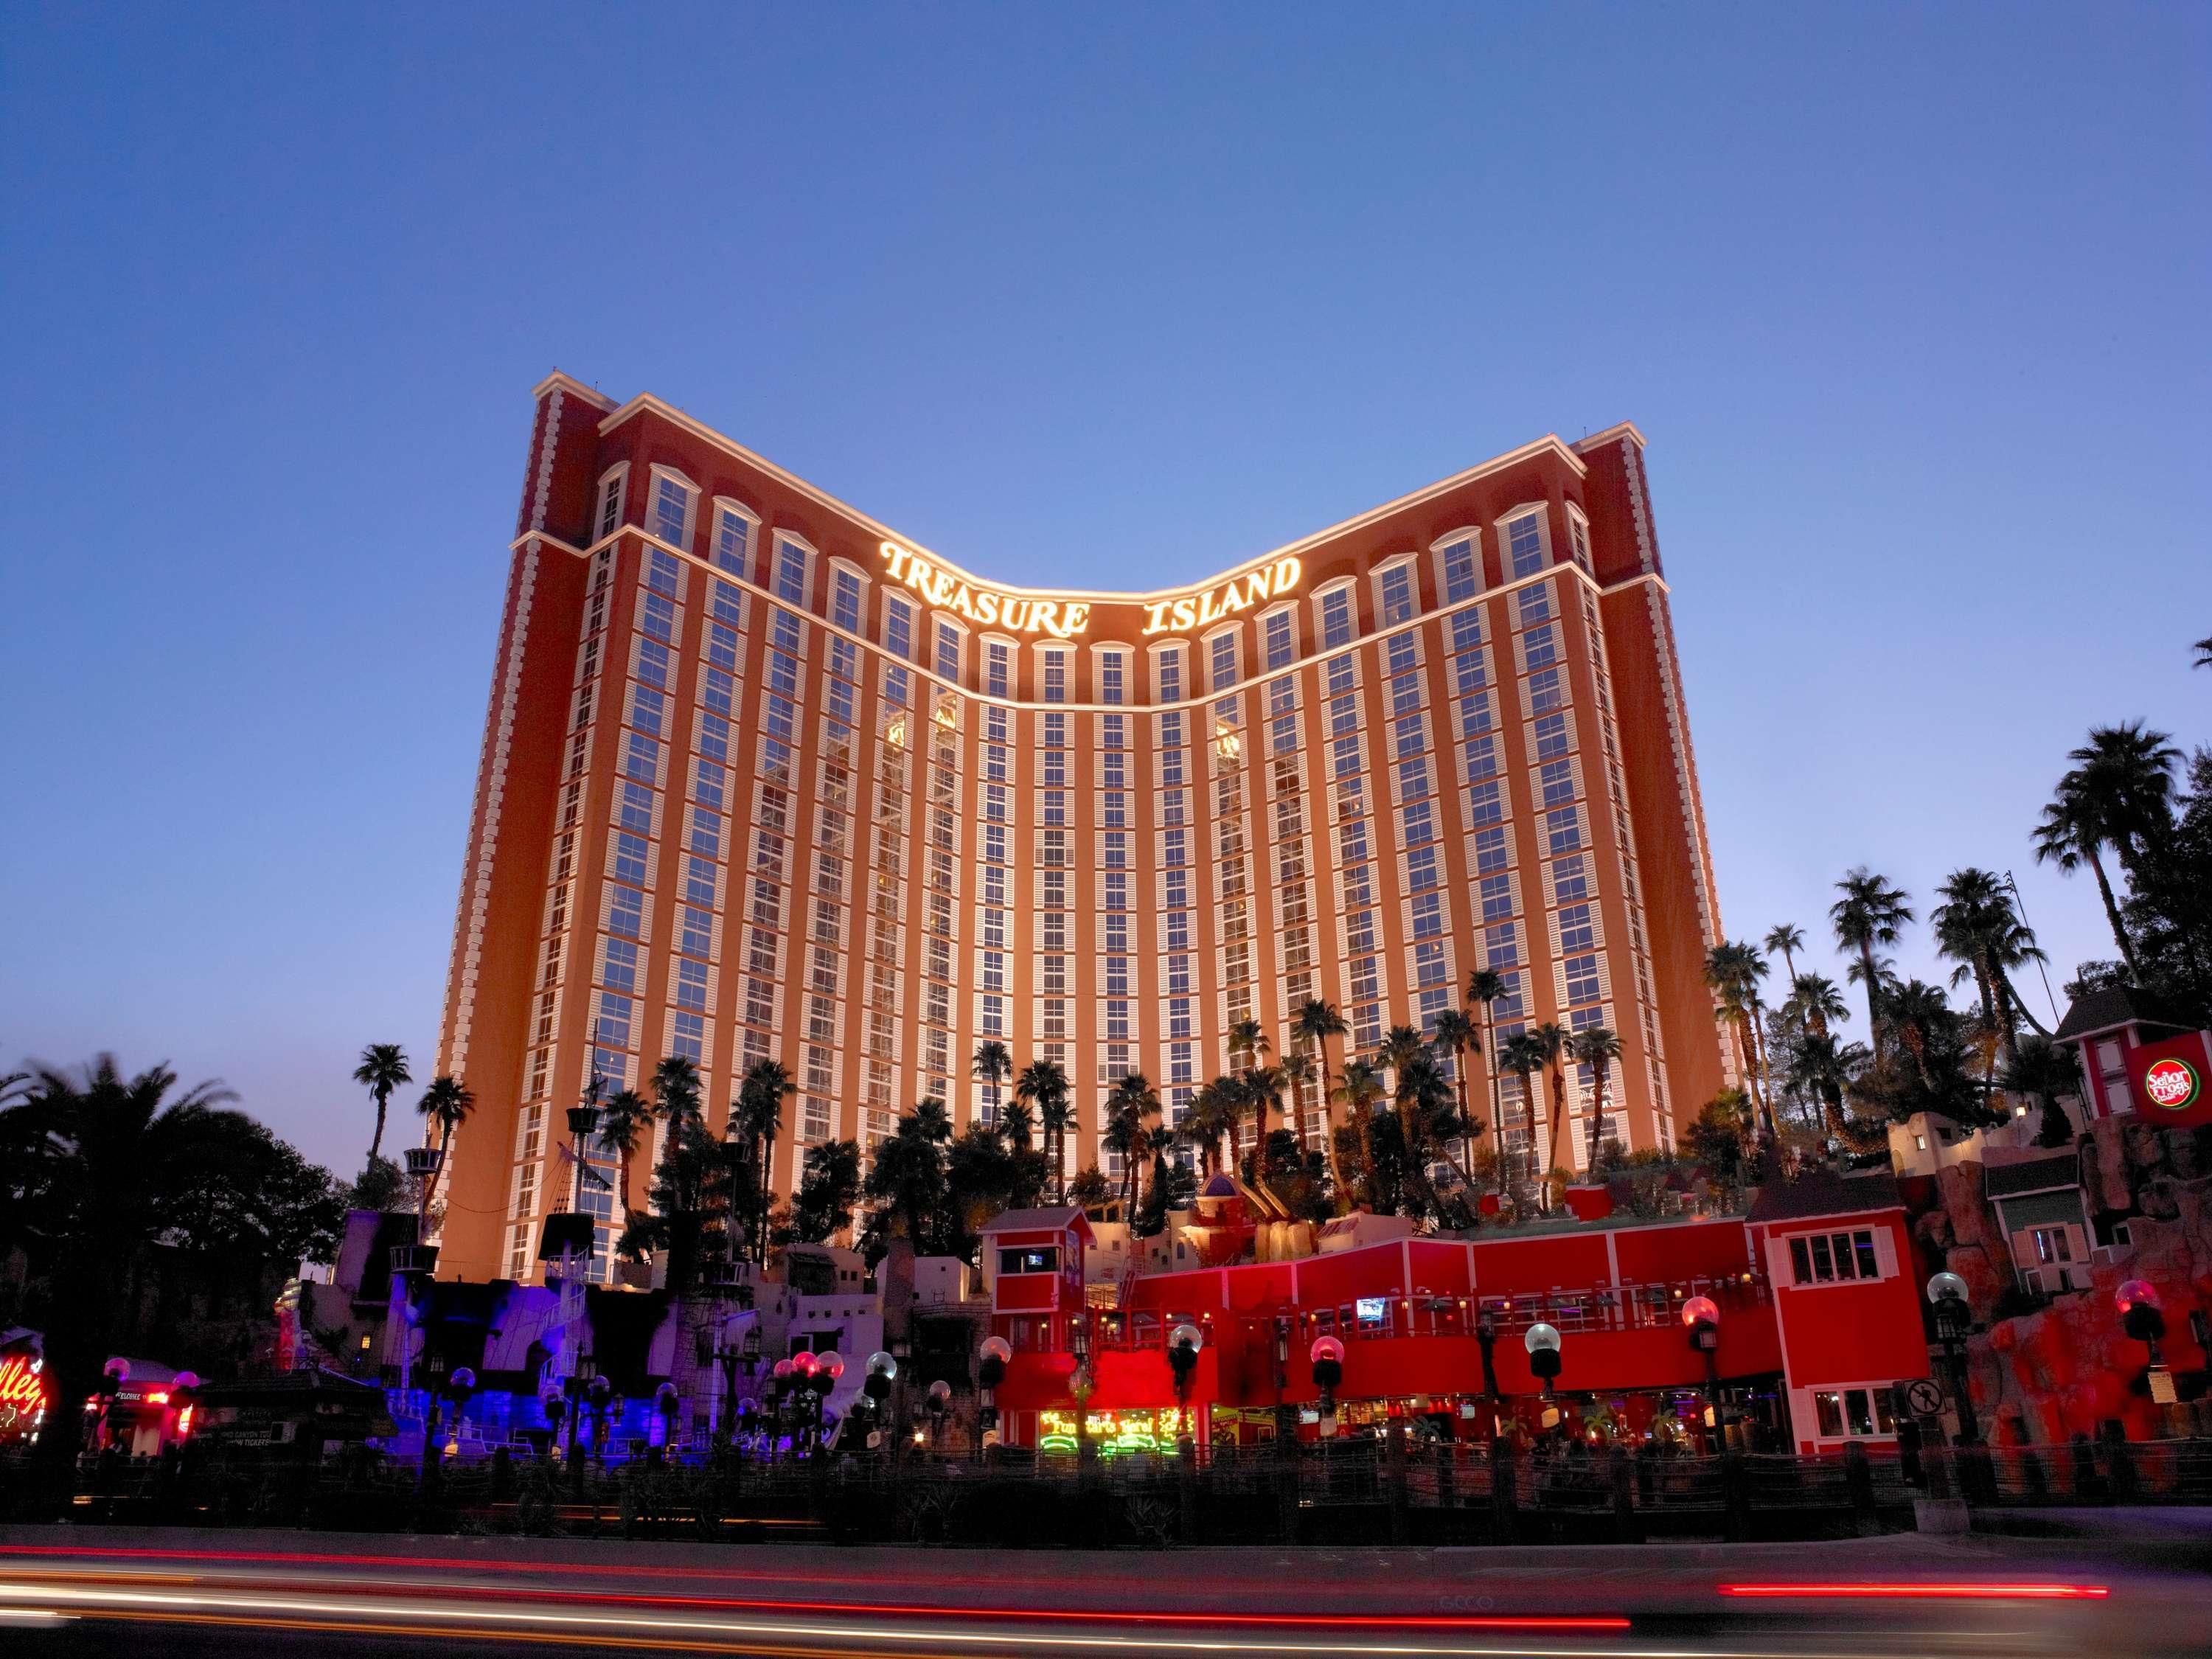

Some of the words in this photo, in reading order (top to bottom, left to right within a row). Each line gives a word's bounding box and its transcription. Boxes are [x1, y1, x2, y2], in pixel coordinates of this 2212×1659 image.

[879, 541, 1091, 639] TREASURE
[1142, 557, 1301, 635] ISLAND
[116, 1391, 141, 1400] WELCOME
